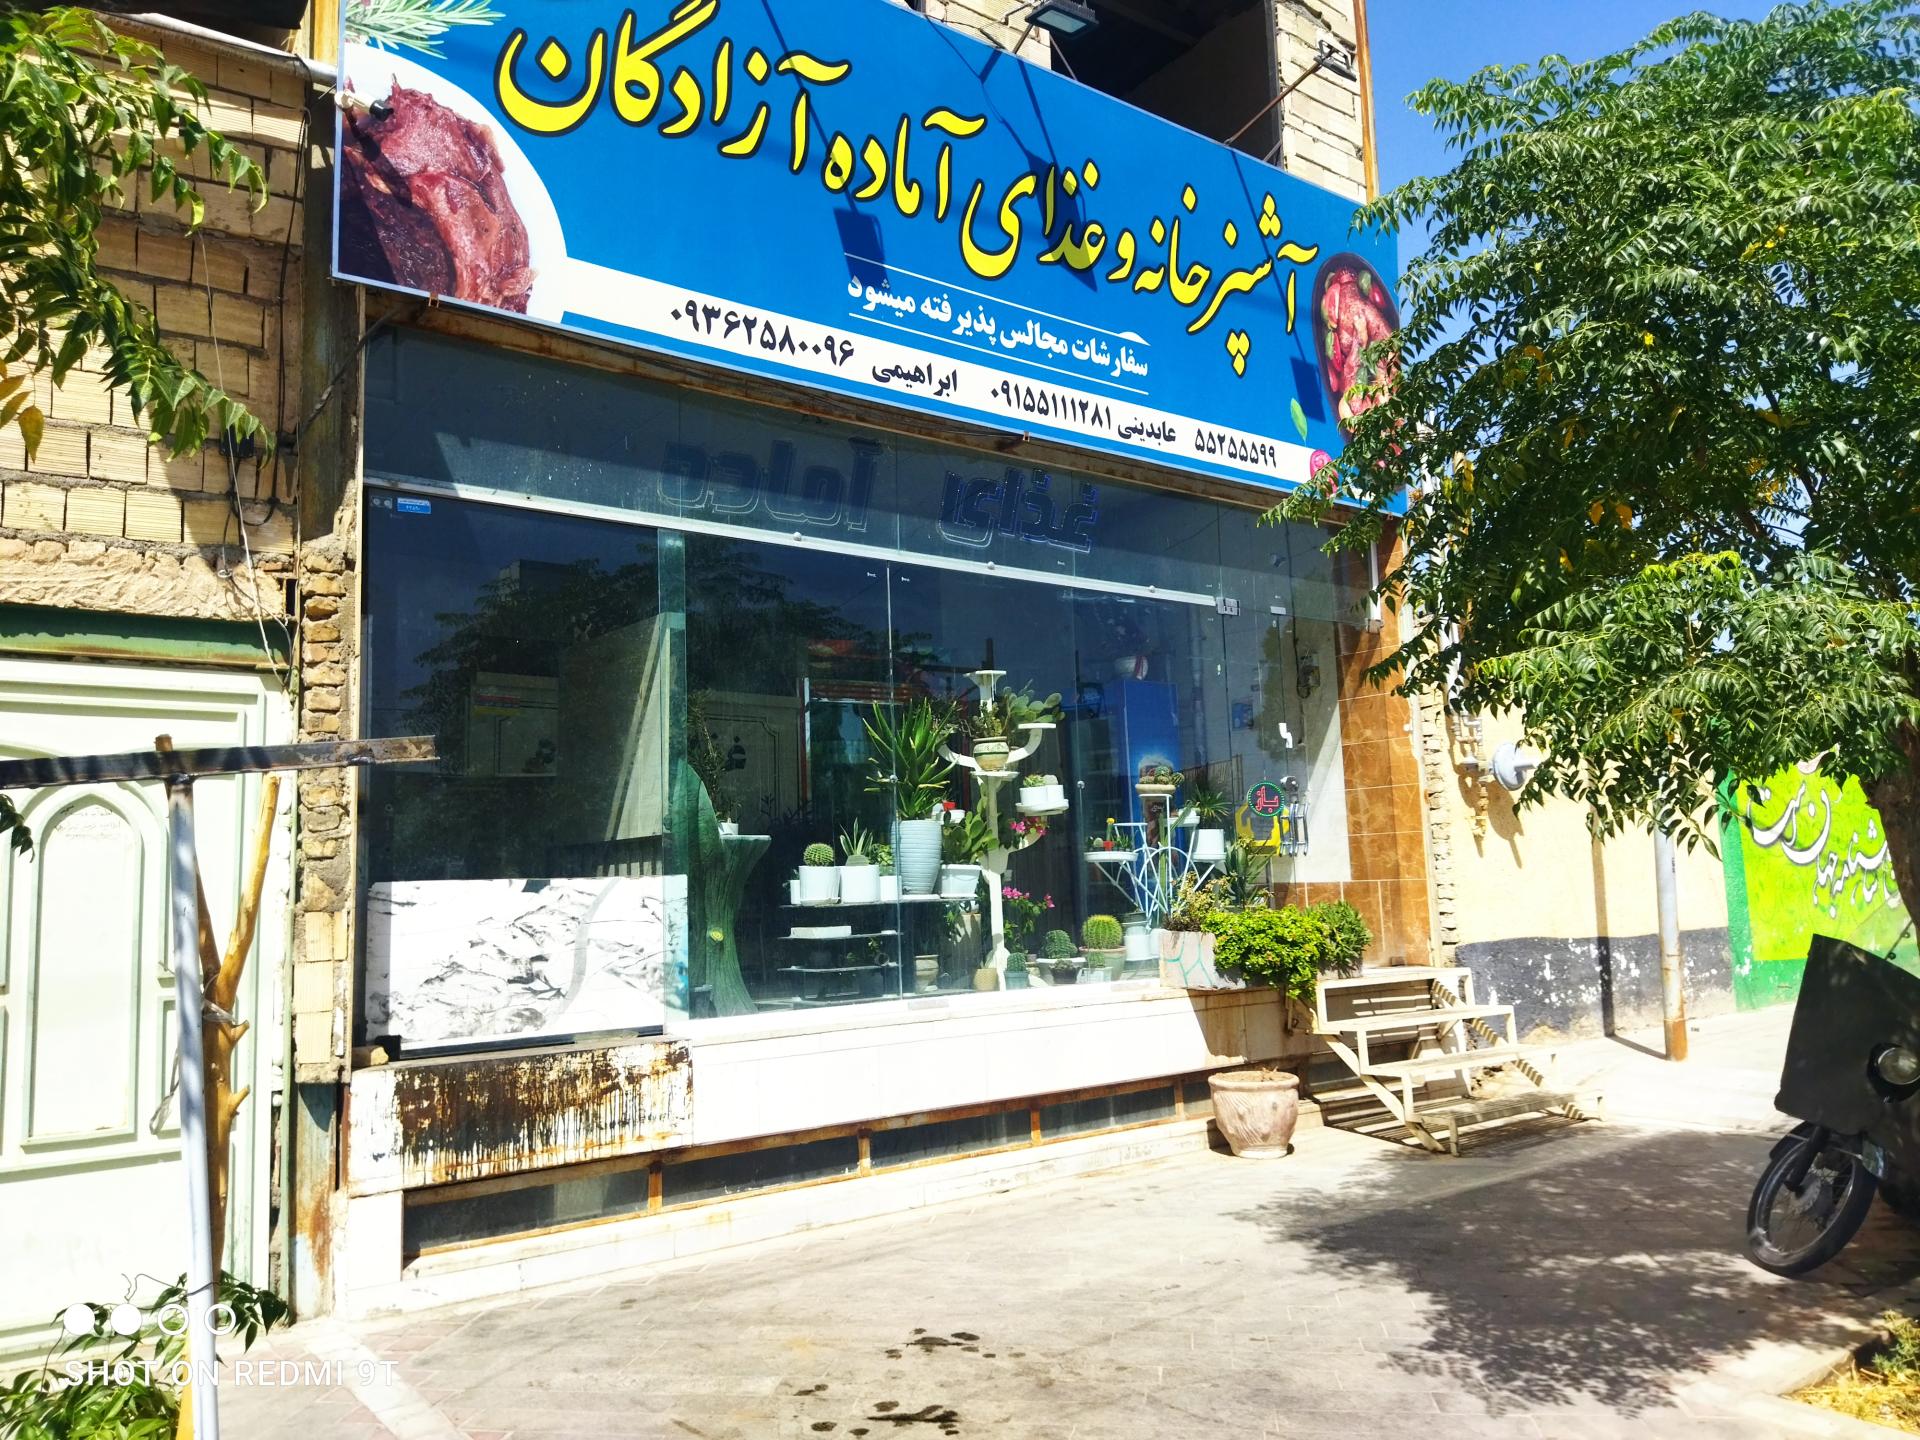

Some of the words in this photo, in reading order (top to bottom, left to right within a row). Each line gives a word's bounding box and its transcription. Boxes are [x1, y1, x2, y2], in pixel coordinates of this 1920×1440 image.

[495, 0, 852, 174] آزادگان
[821, 107, 986, 222] آماده
[959, 160, 1106, 281] غذای
[1106, 228, 1136, 282] و
[1133, 183, 1319, 377] آشپزخانه
[847, 275, 916, 318] میشود
[920, 293, 996, 346] پذیرفته
[671, 299, 855, 367] ۰۹۳۶۲۵۸۰۰۹۶
[1000, 320, 1068, 359] مجالس
[1072, 338, 1149, 378] سفارشات
[872, 362, 958, 397] ابراهیمی
[991, 379, 1112, 430] ۰۹۱۵۵۱۱۱۲۸۱
[1117, 417, 1177, 446] عابدینی
[1194, 428, 1277, 468] ۵۵۲۵۵۵۹۹
[935, 466, 1098, 554] غذای
[1255, 785, 1279, 813] باز
